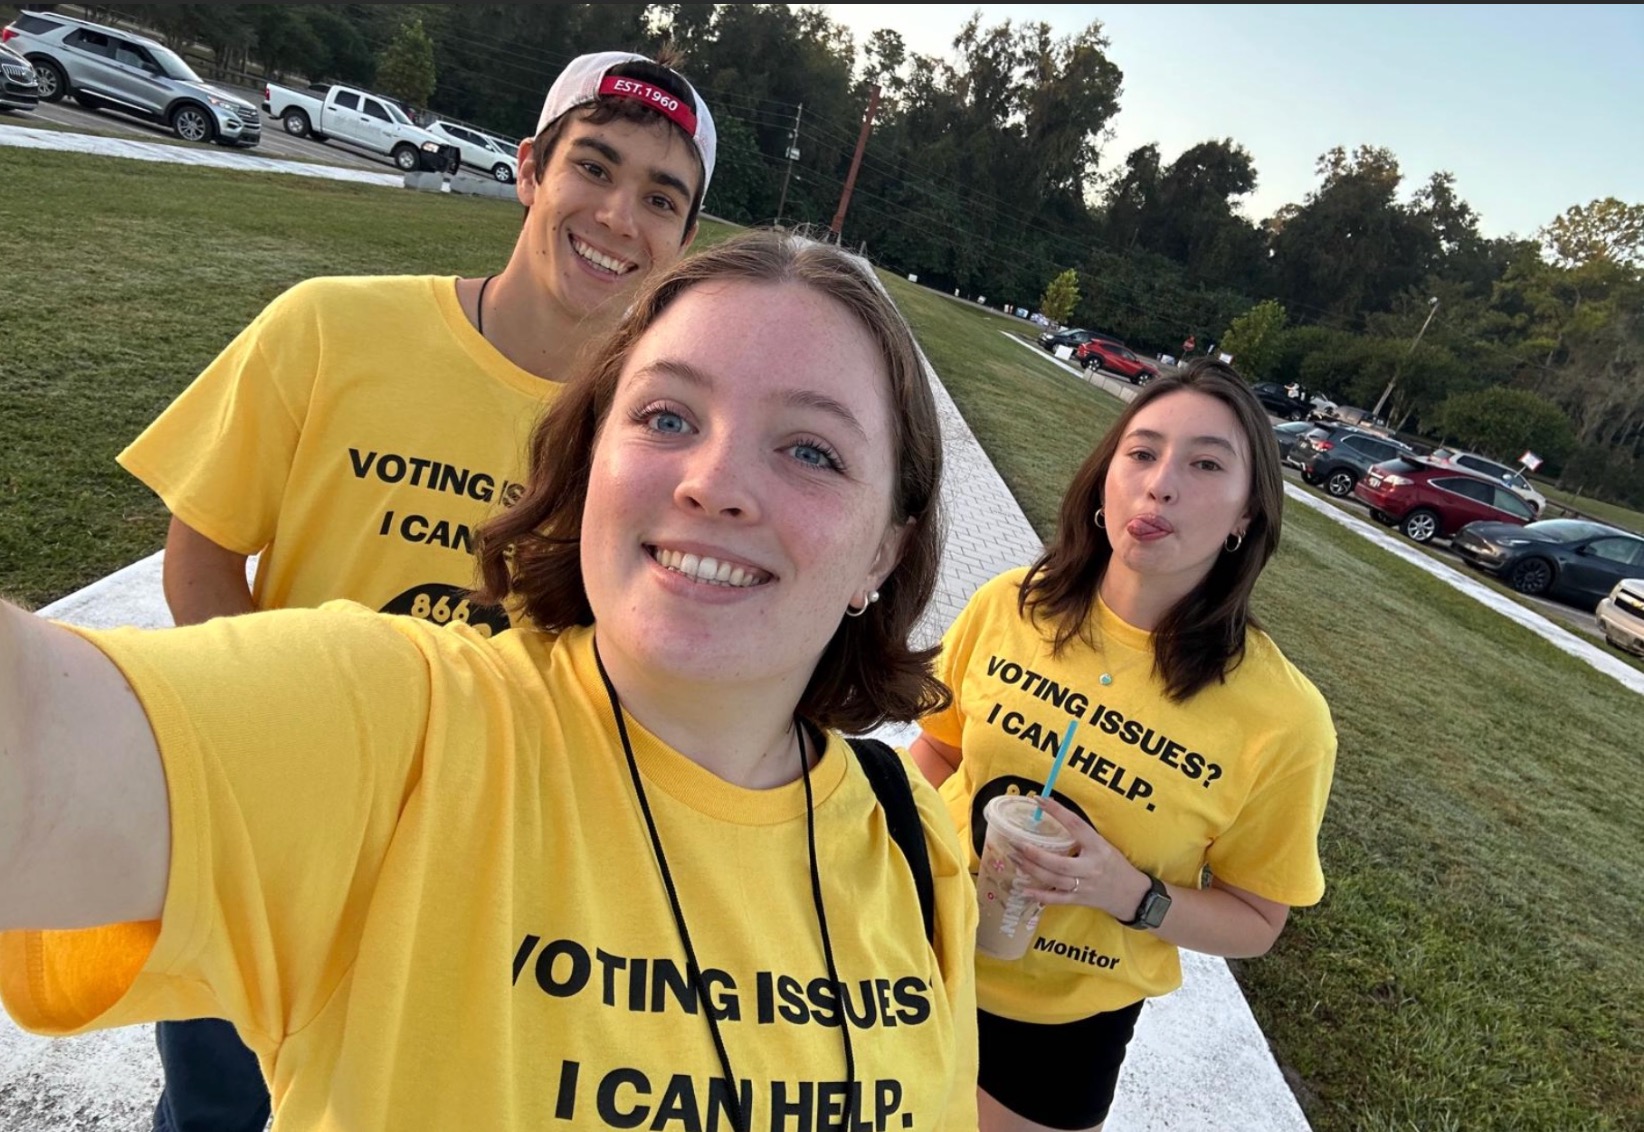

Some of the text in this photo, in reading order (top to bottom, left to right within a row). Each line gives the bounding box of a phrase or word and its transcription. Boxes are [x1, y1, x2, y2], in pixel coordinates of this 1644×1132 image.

[348, 448, 495, 503] VOTING
[379, 511, 474, 555] I CAN
[411, 593, 470, 623] 866
[987, 655, 1222, 788] VOTING ISSUES?
[986, 703, 1156, 812] I CAN HELP.
[1033, 936, 1120, 970] Monitor
[555, 1059, 913, 1132] I CAN HELP.
